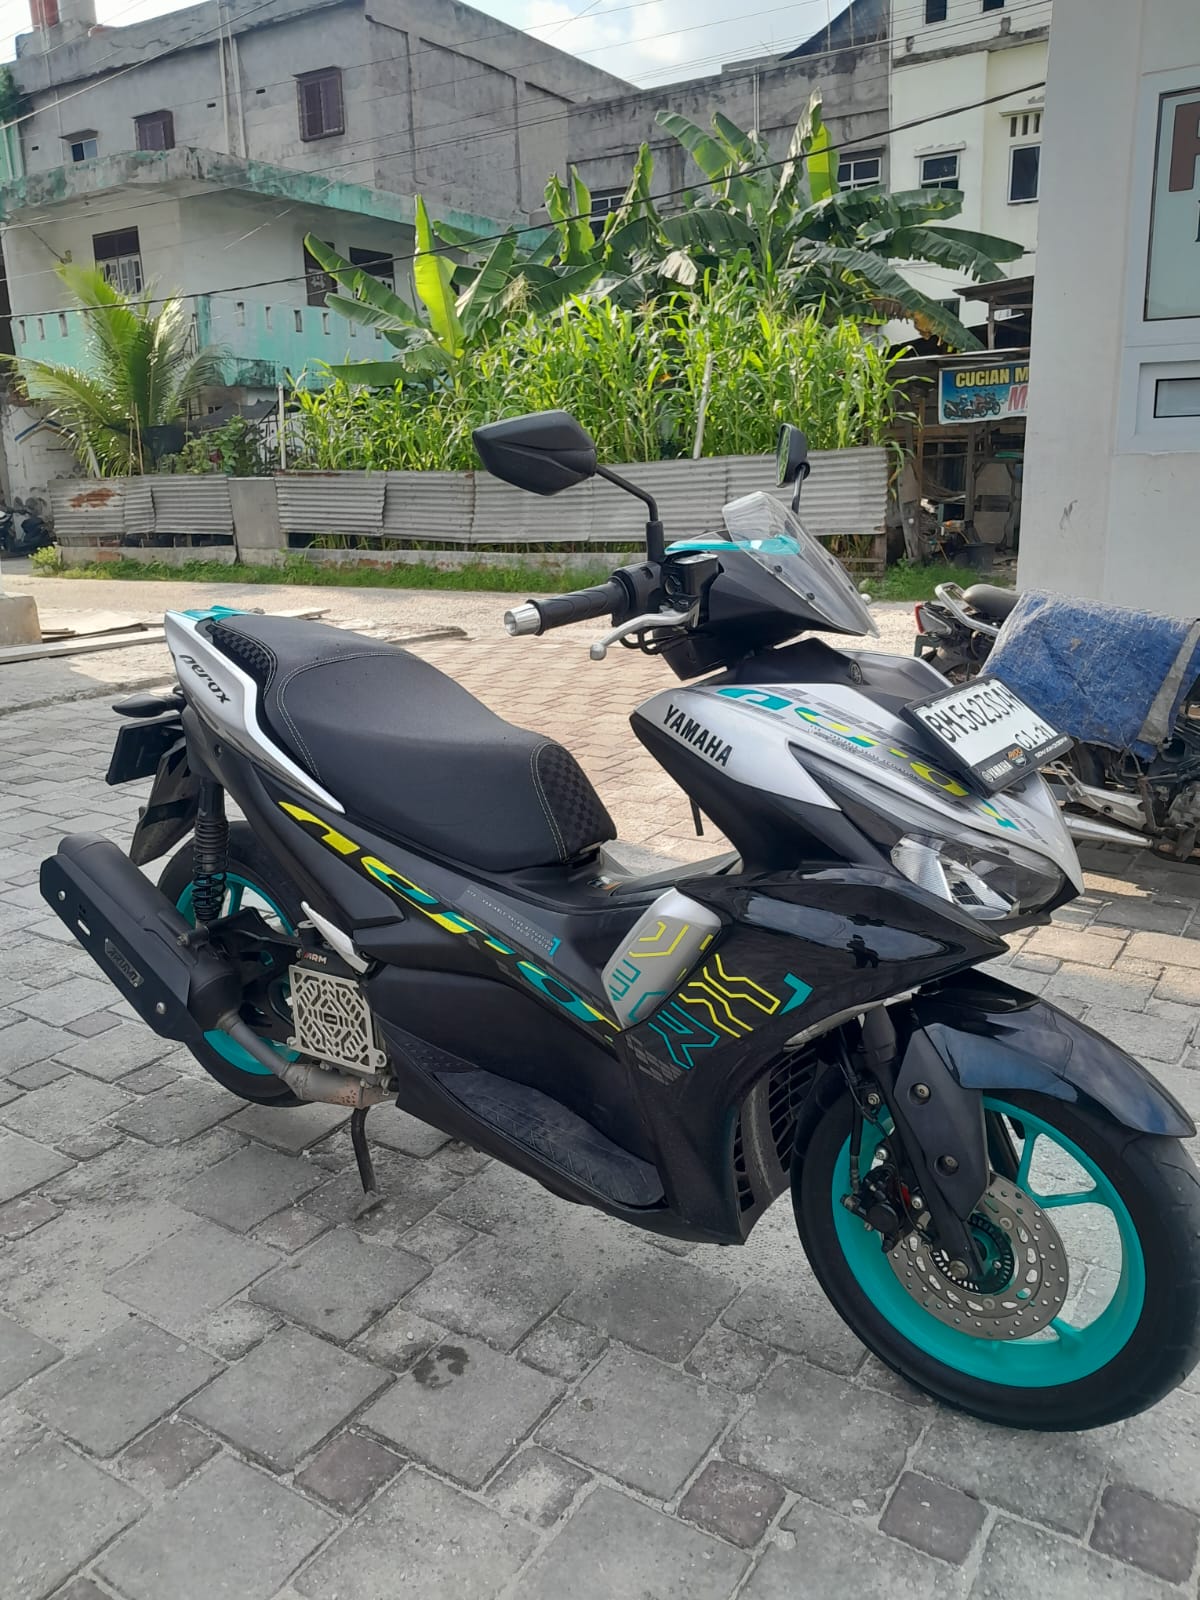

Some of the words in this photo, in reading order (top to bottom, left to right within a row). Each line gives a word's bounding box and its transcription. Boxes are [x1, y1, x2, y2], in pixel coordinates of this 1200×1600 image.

[955, 368, 1010, 387] CUCIAN
[663, 703, 733, 767] YAMAHA
[925, 709, 969, 743] BM
[949, 694, 1003, 731] 5623
[987, 759, 1014, 779] YAMAHA
